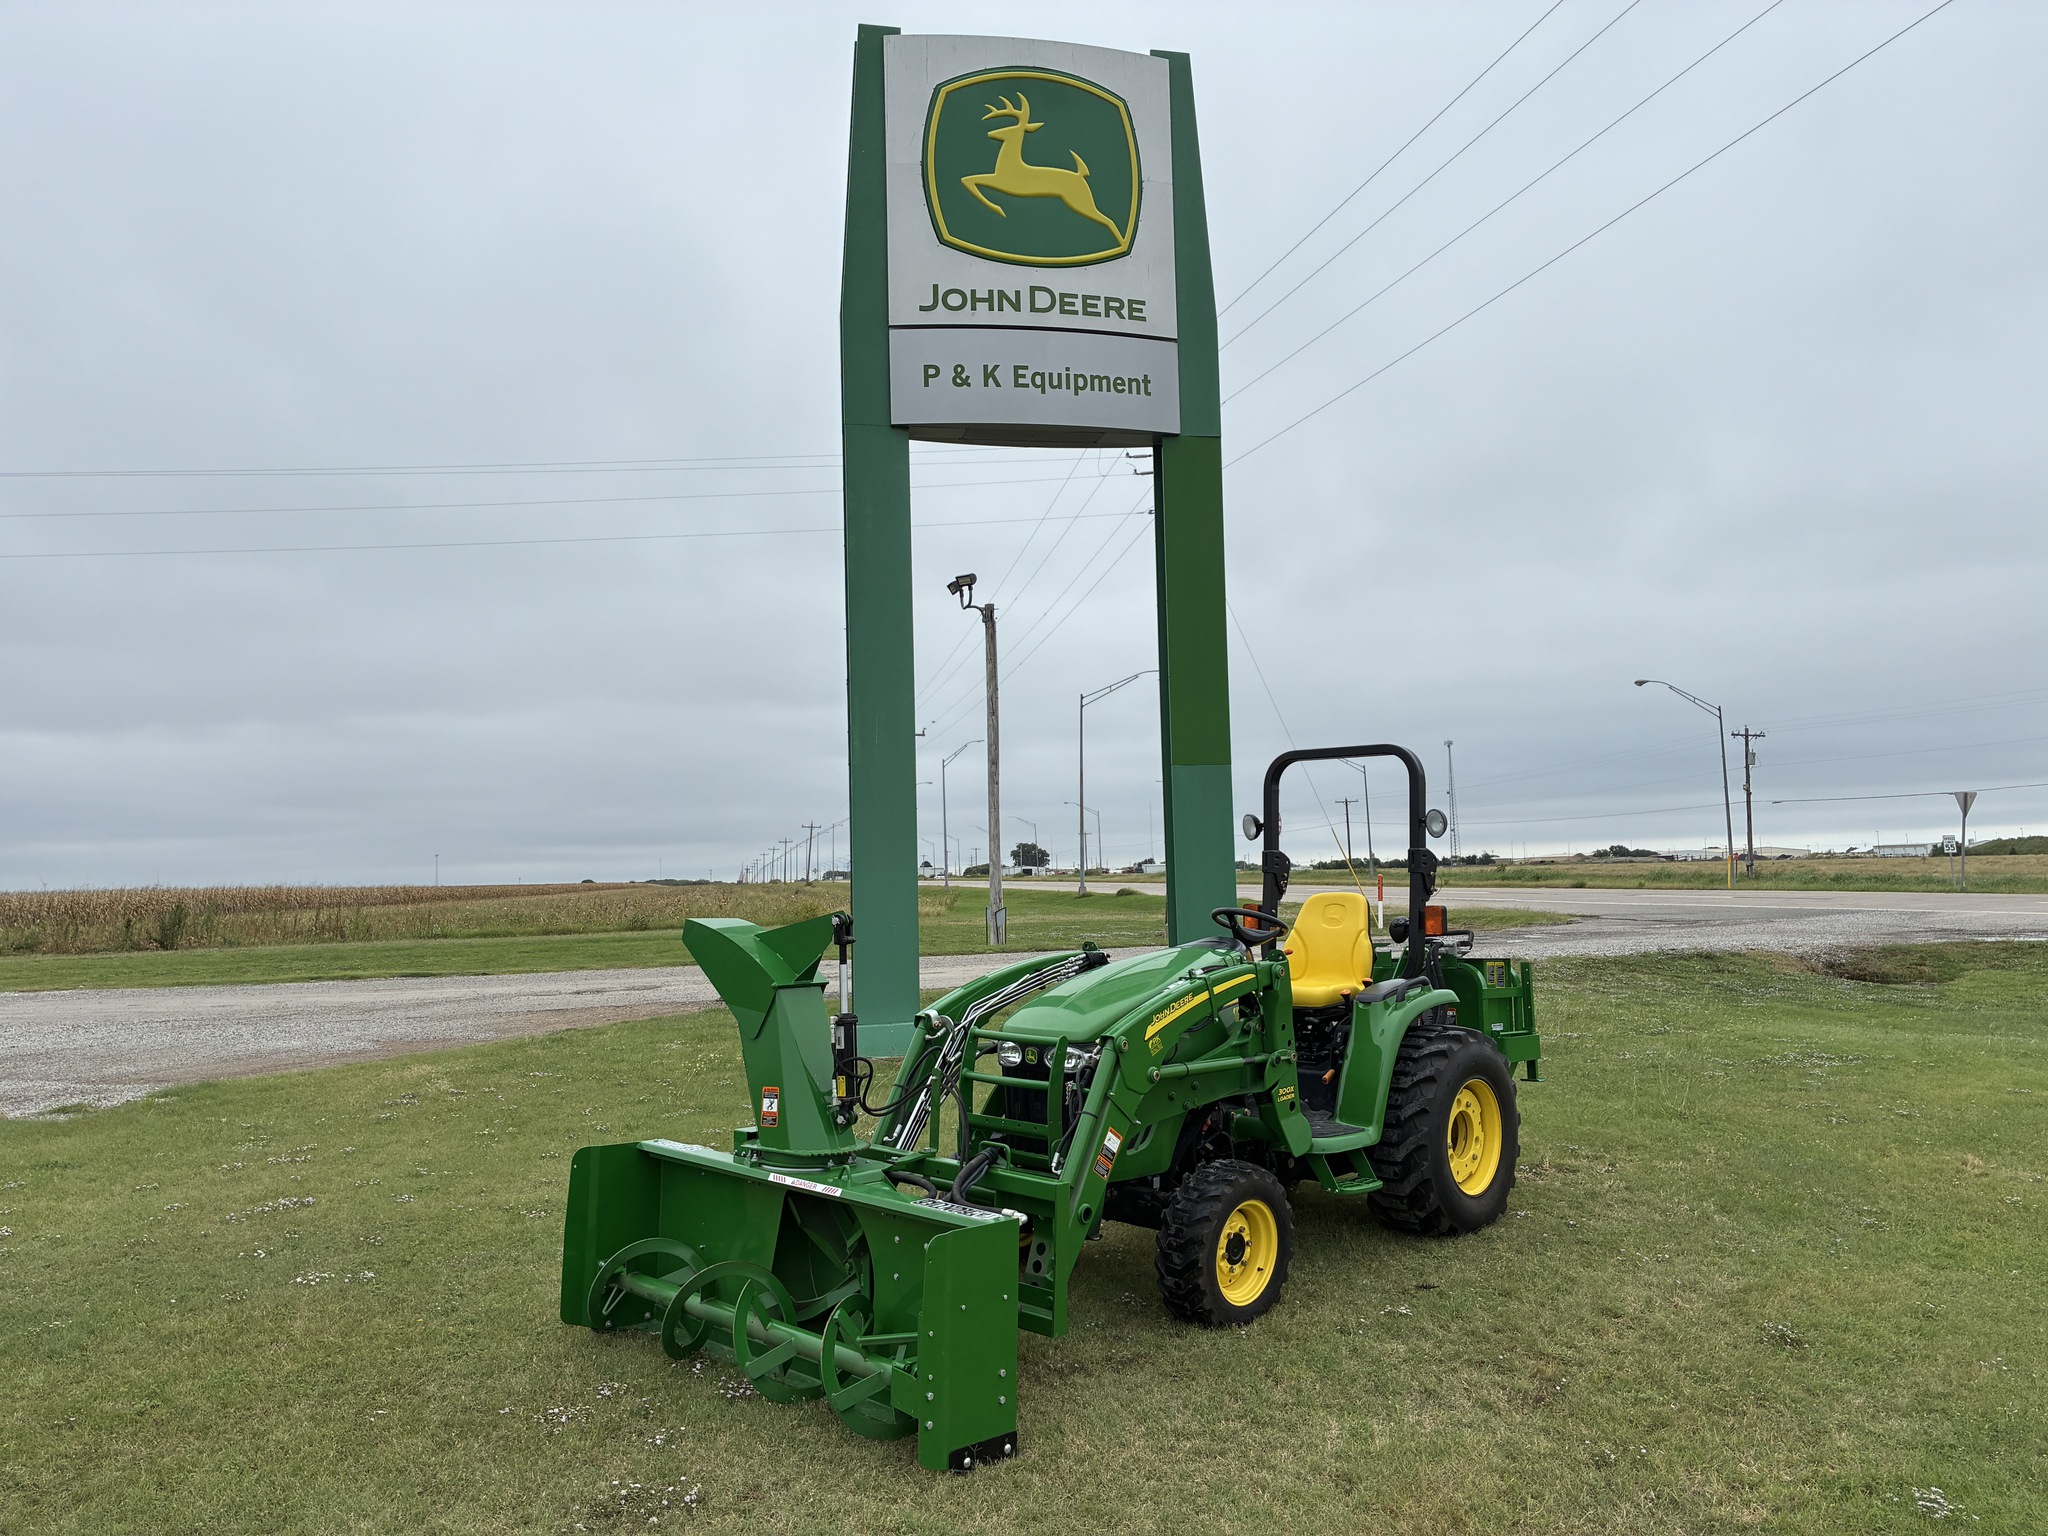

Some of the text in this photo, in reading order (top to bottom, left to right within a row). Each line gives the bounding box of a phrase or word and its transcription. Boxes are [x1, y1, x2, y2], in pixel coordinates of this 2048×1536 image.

[918, 283, 1147, 323] JOHN DEERE
[922, 363, 1152, 397] P & K Equipment
[1151, 992, 1194, 1026] JOHN DEERE
[794, 1179, 818, 1190] DANGER
